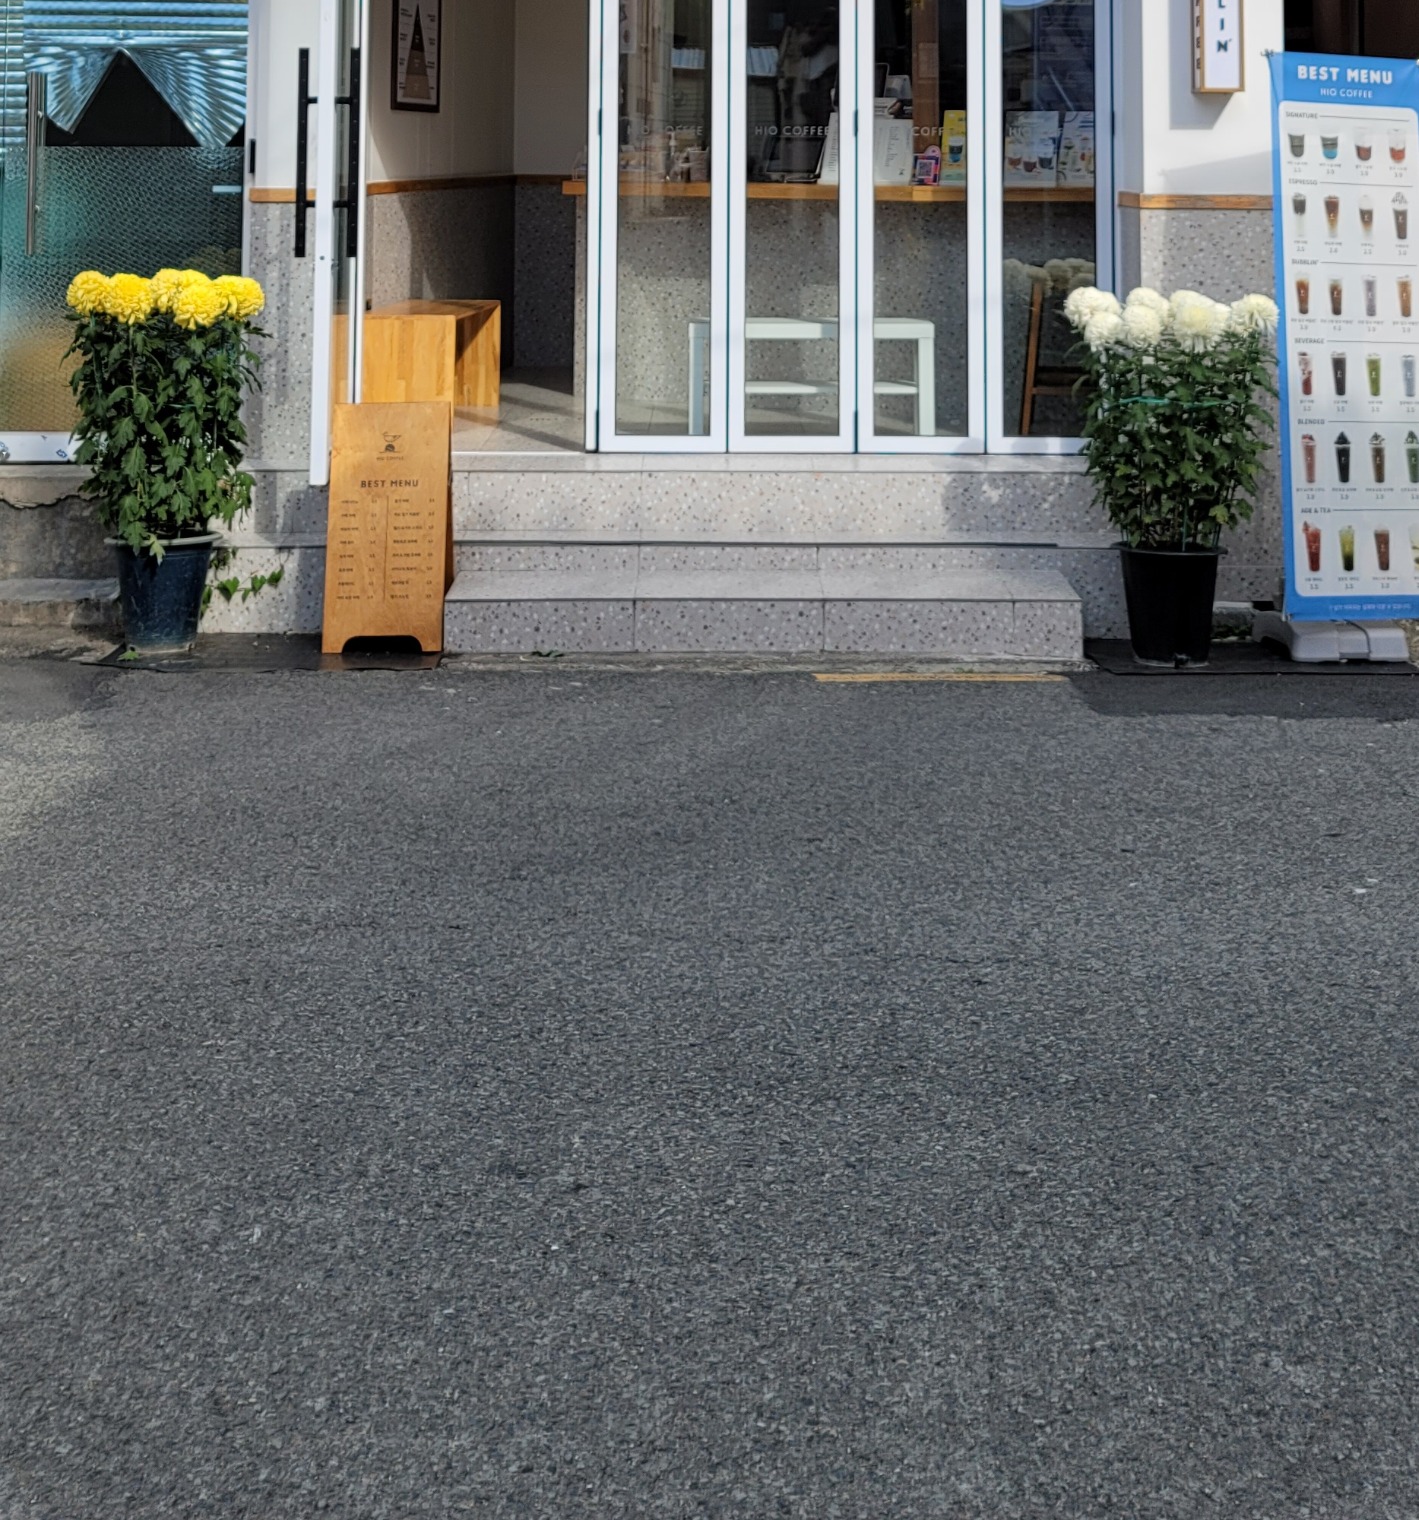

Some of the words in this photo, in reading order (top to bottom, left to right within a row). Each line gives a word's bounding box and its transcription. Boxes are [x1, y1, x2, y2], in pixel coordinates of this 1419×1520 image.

[1297, 64, 1340, 82] BEST
[1346, 68, 1393, 85] MENU
[1320, 87, 1337, 96] HIO
[1339, 88, 1373, 99] COFFEE
[755, 125, 778, 136] HIO
[360, 480, 386, 488] BEST
[390, 479, 419, 488] MENU
